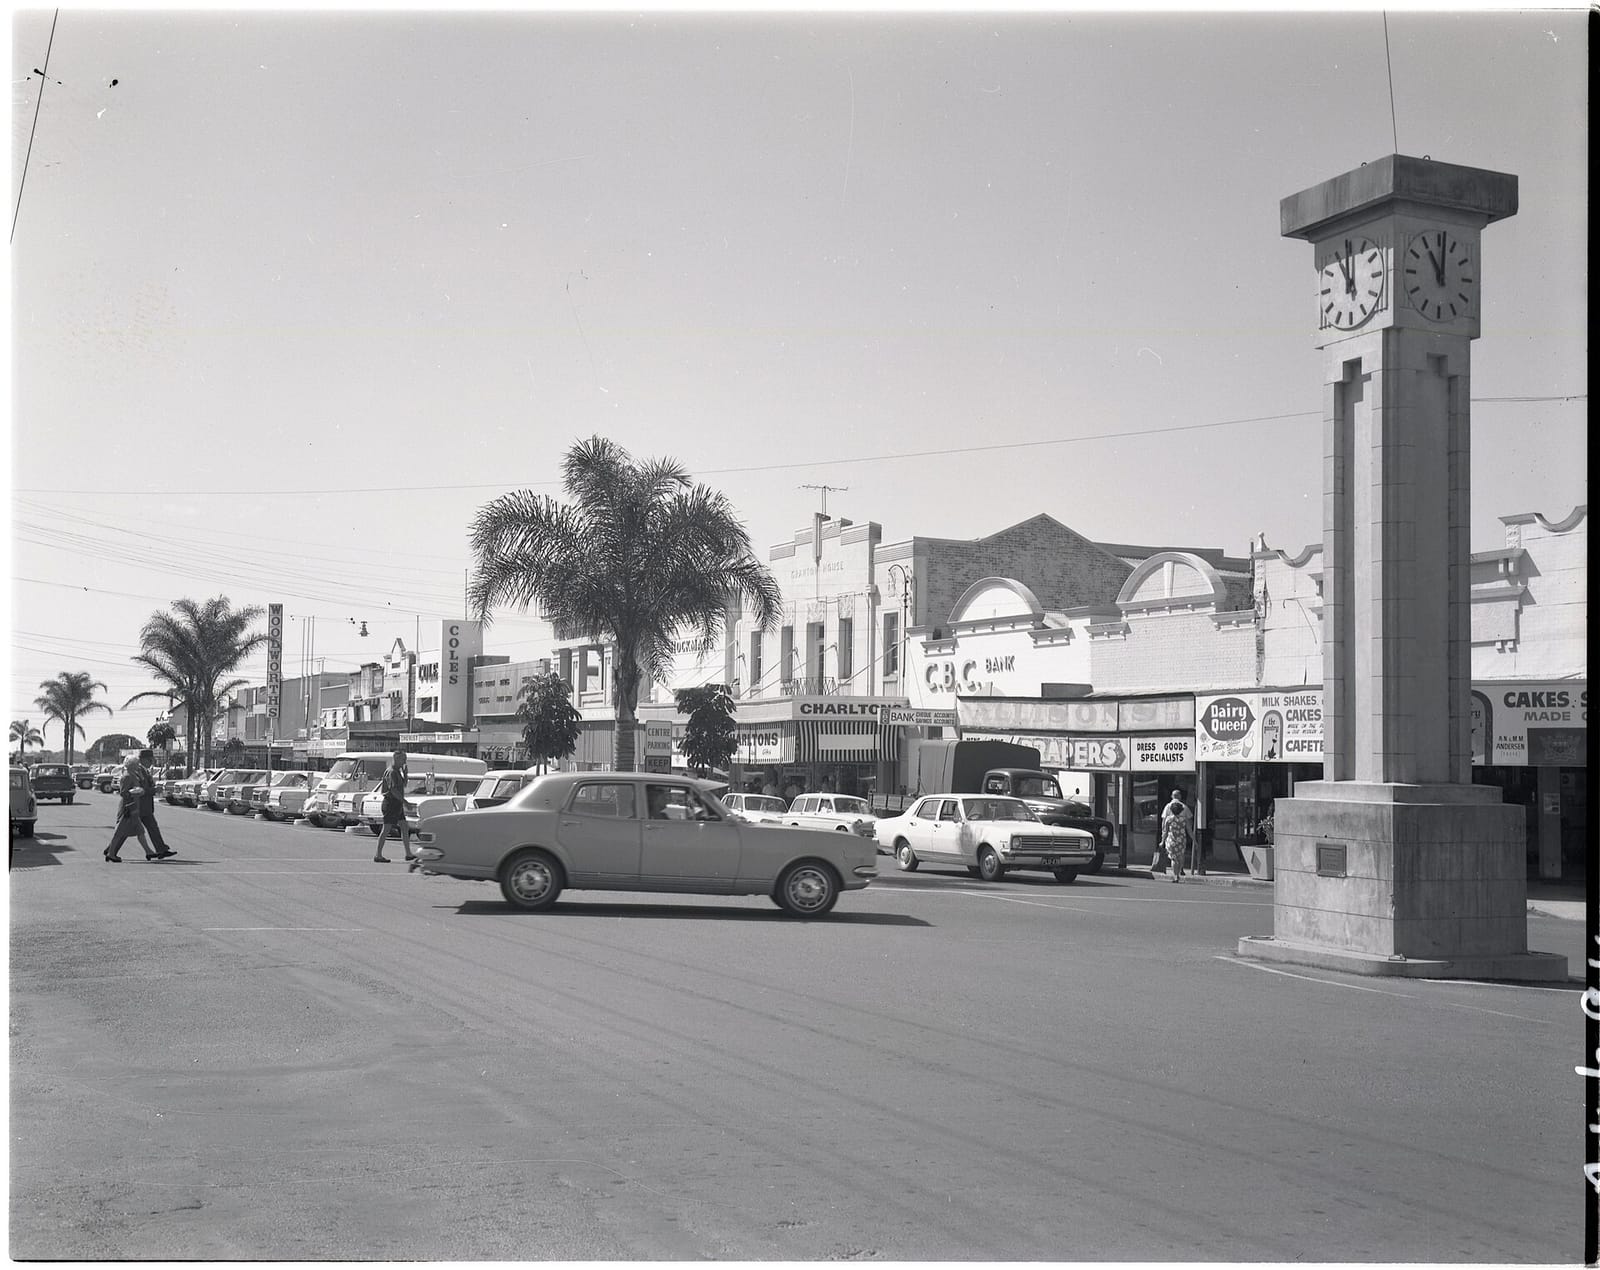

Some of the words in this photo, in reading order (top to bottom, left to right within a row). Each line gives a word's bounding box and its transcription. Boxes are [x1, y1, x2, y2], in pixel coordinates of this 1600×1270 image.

[448, 625, 460, 685] COLES
[985, 655, 1016, 673] BANK
[1261, 697, 1280, 707] MILK
[800, 703, 902, 715] CHARLTO
[1210, 703, 1247, 720] Dairy
[891, 712, 915, 722] BANK
[1285, 708, 1322, 721] CAKES
[1524, 711, 1571, 721] MADE
[1211, 718, 1248, 734] Queen
[647, 728, 671, 737] CENTRE
[647, 741, 671, 750] PARKING
[1136, 742, 1156, 751] DRESS
[1163, 741, 1188, 750] GOODS
[1140, 752, 1184, 762] SPECIALISTS
